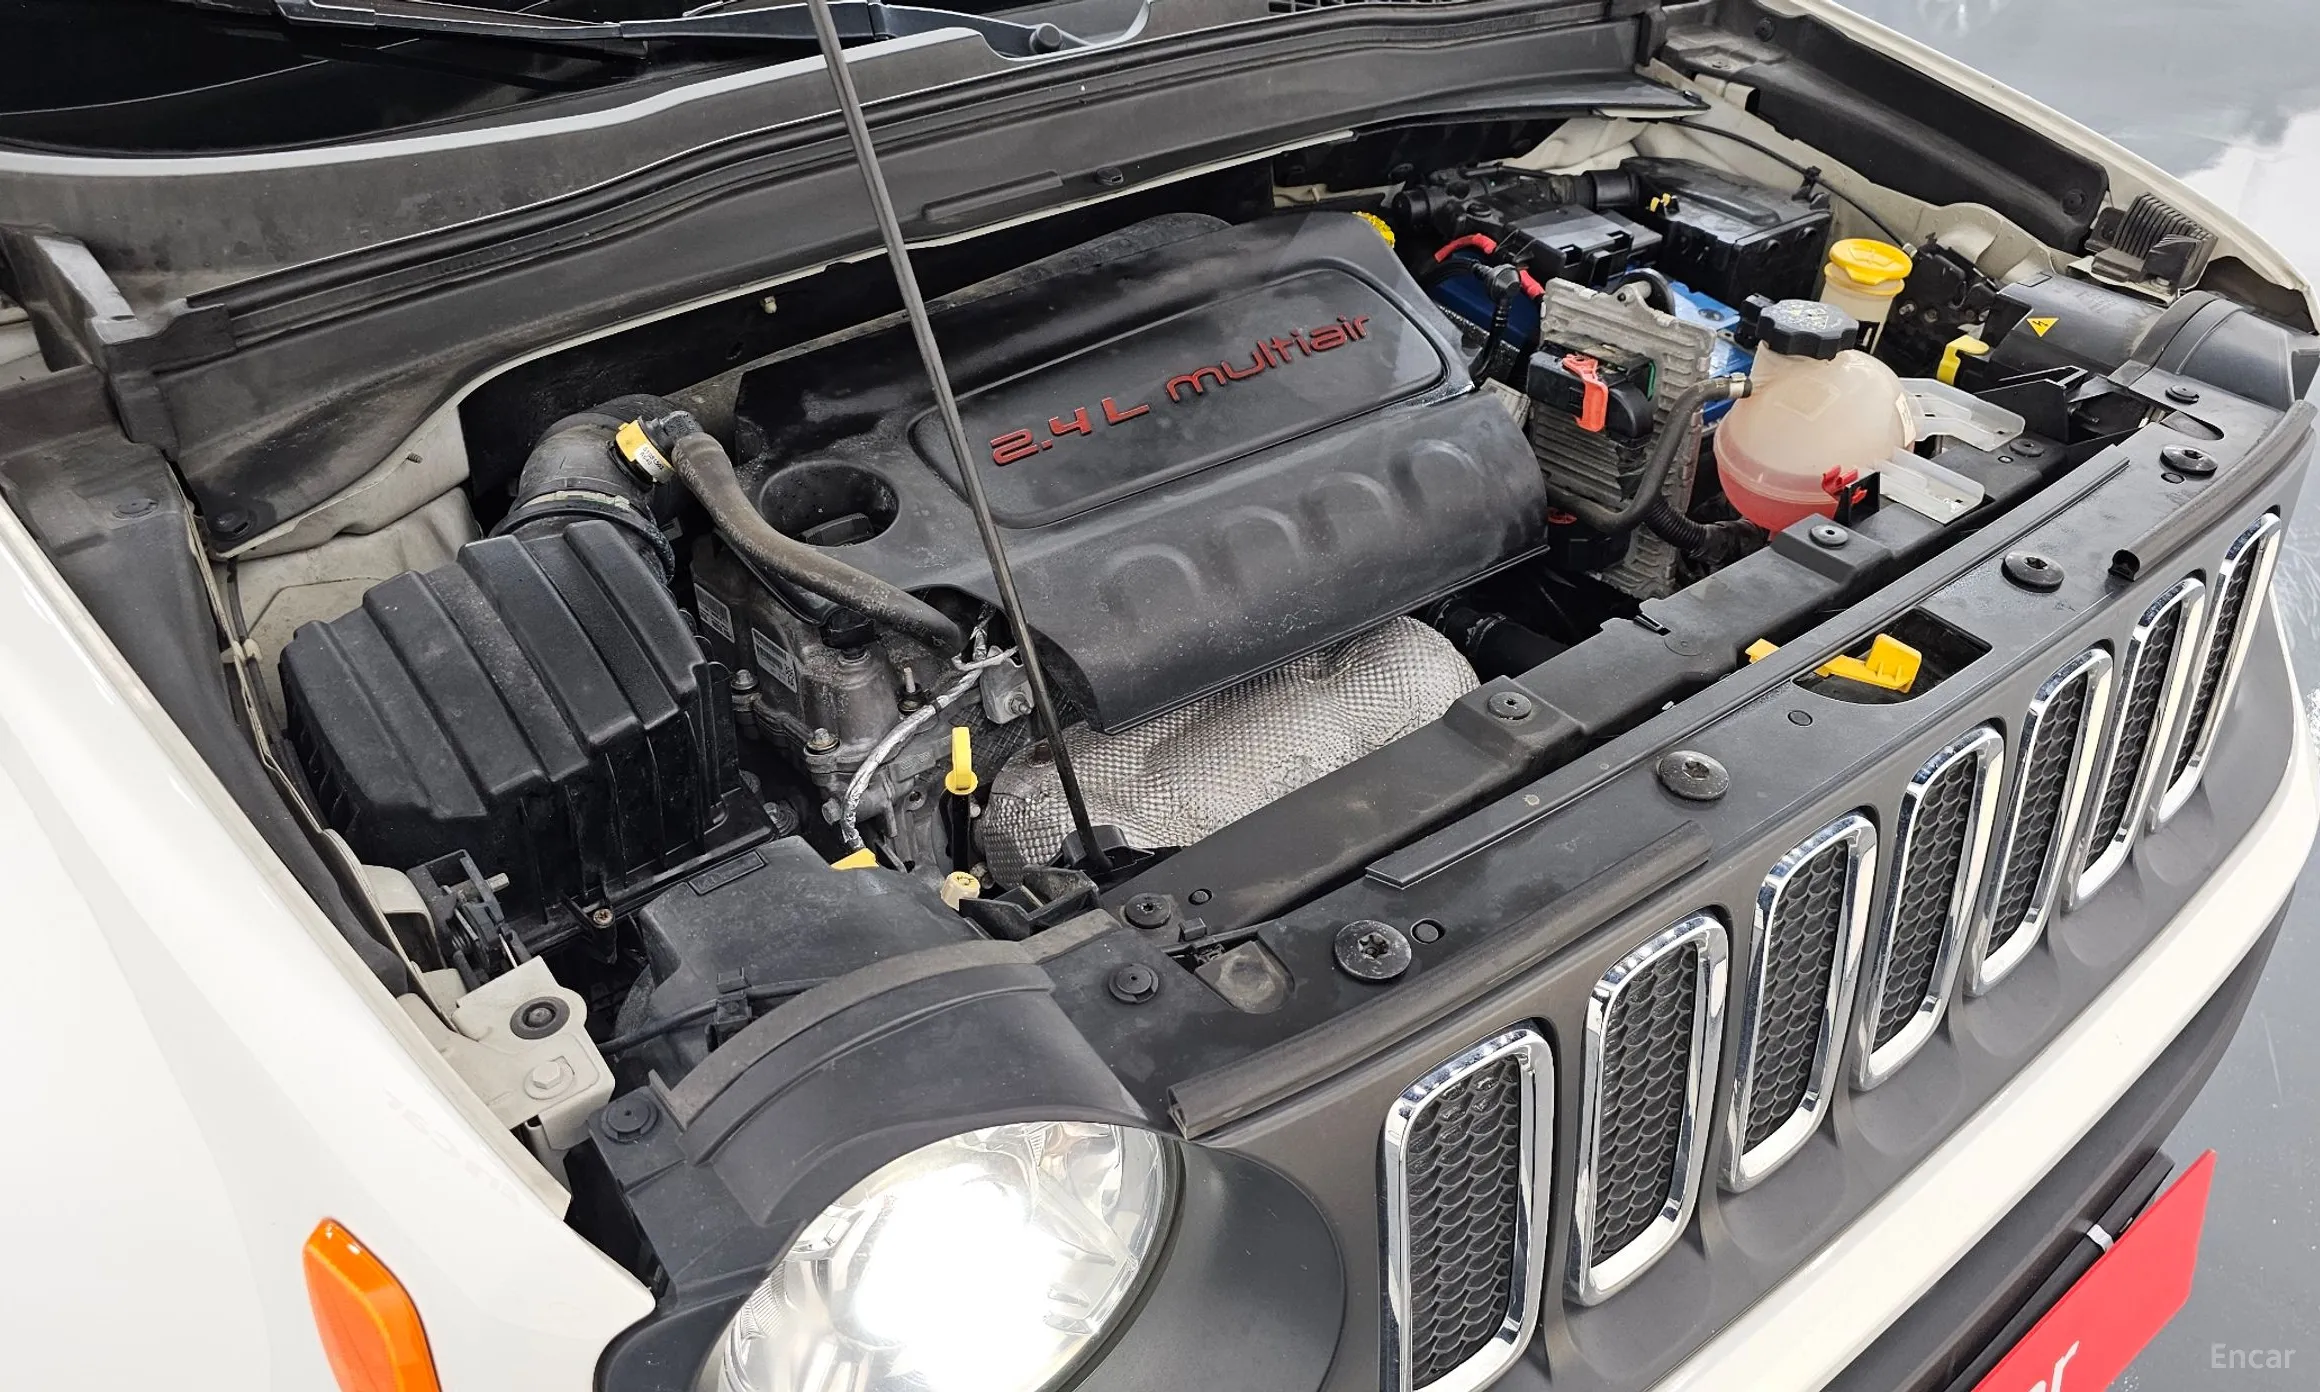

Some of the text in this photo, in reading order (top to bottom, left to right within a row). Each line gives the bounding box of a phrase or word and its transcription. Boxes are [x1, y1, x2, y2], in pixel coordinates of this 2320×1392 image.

[990, 313, 1371, 466] 2.4 L multiair
